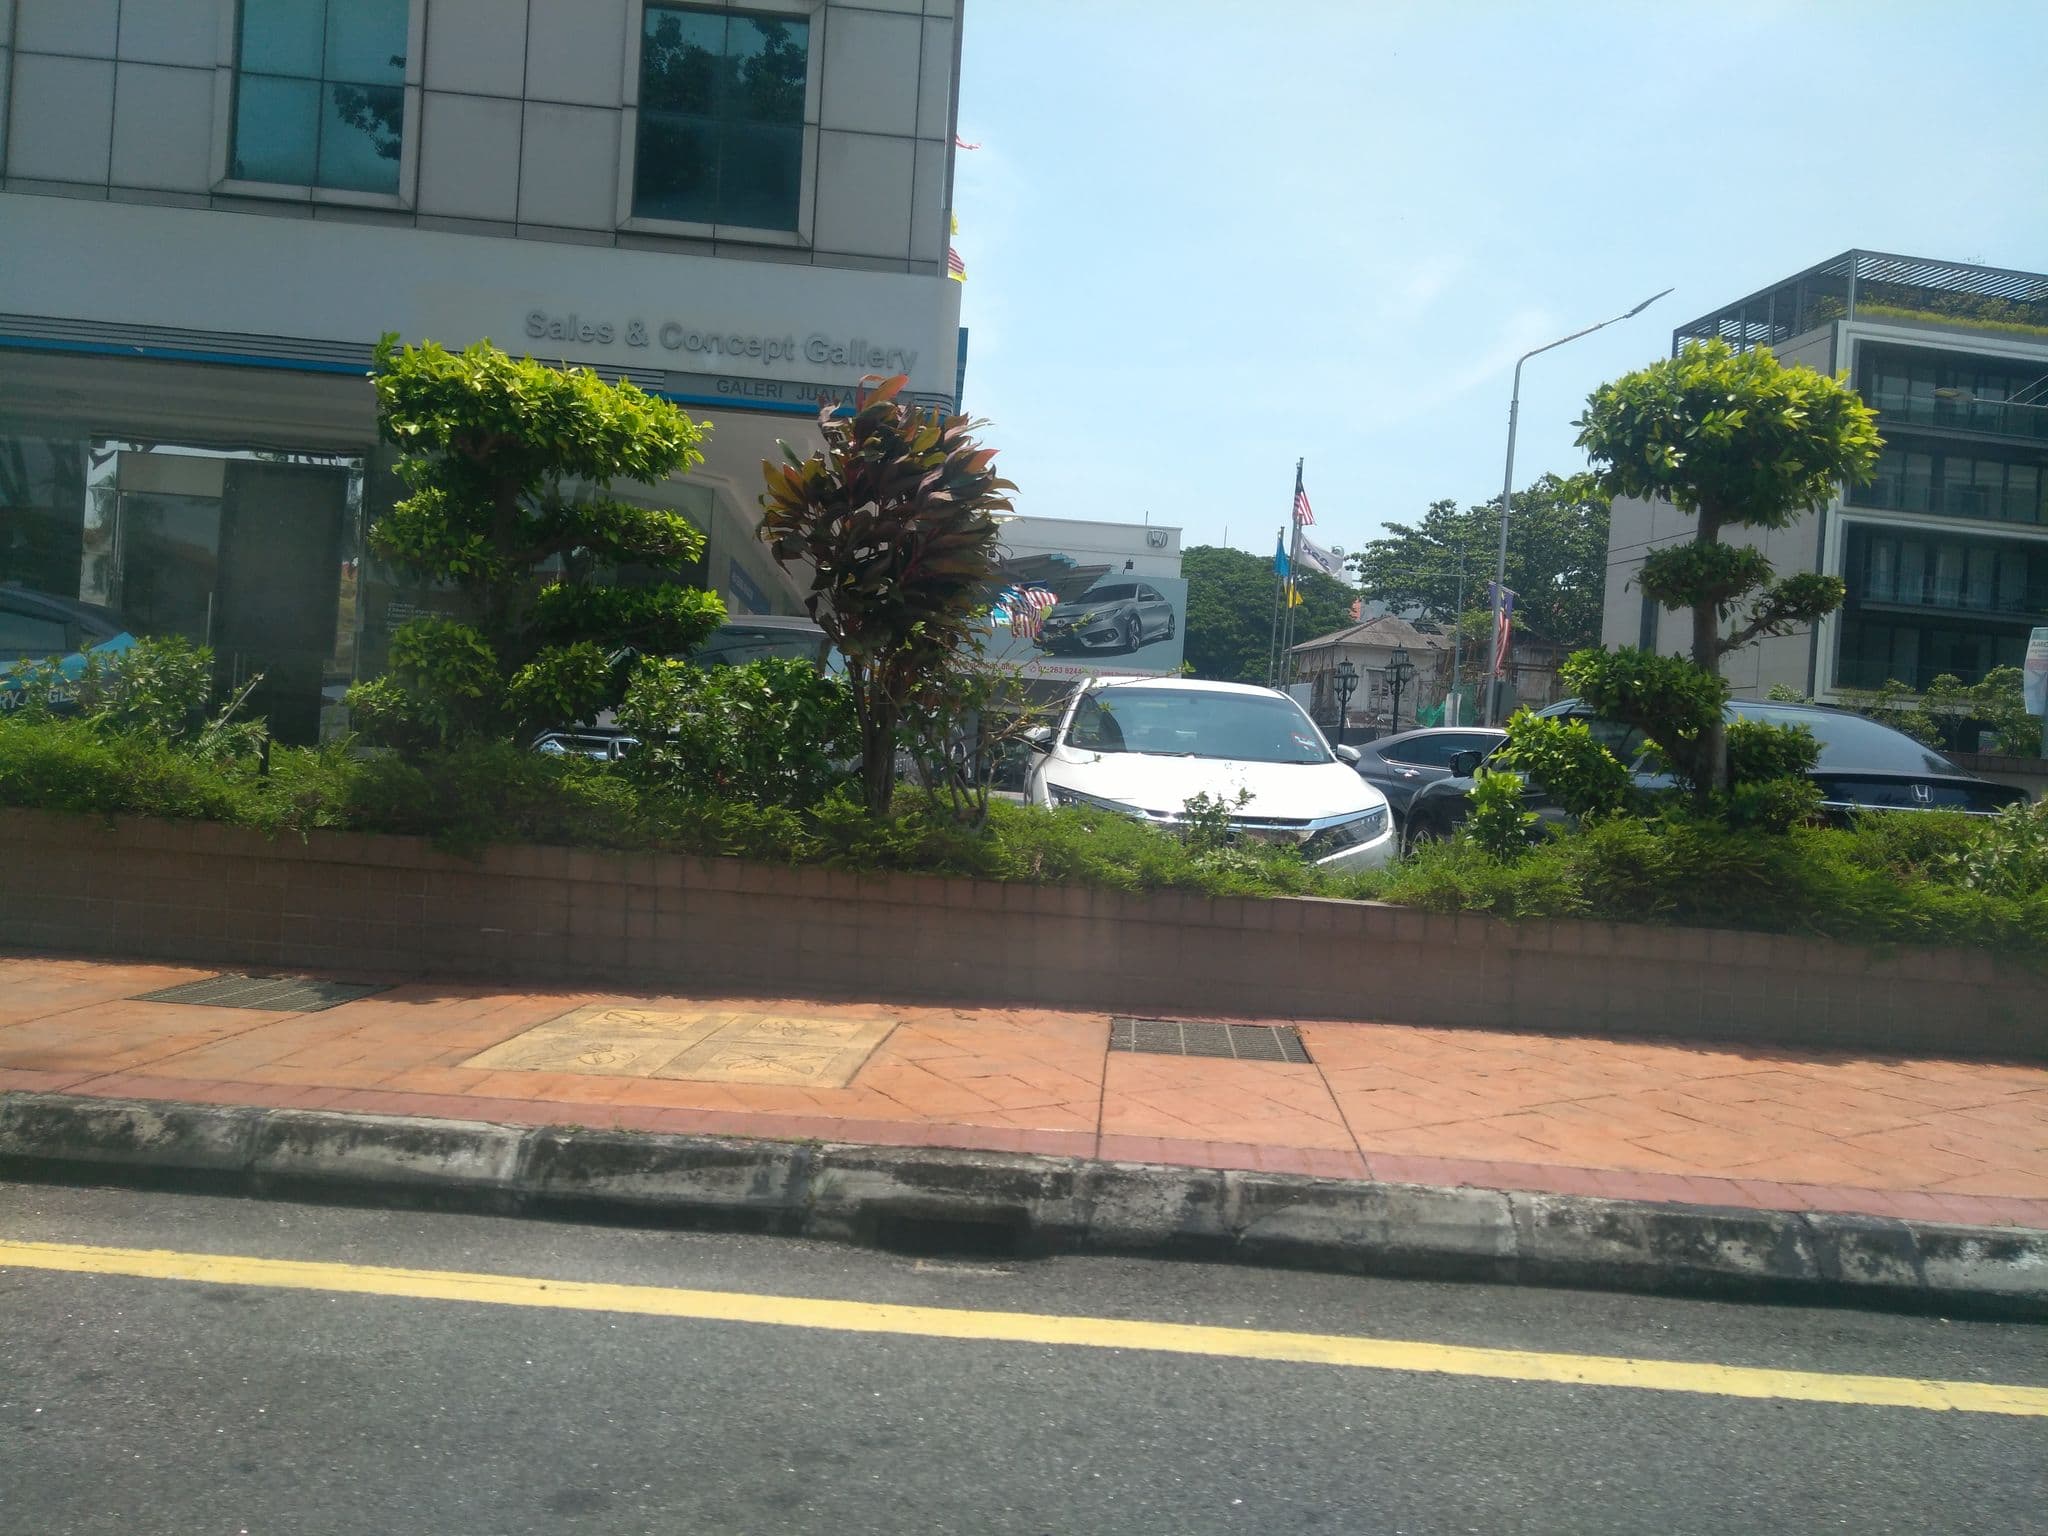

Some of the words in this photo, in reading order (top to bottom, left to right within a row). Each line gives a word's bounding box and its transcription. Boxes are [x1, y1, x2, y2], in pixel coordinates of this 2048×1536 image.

[525, 310, 615, 344] Sales
[624, 318, 649, 347] &
[659, 320, 795, 365] Concept
[805, 334, 918, 375] Gallery
[716, 379, 783, 399] GALERI
